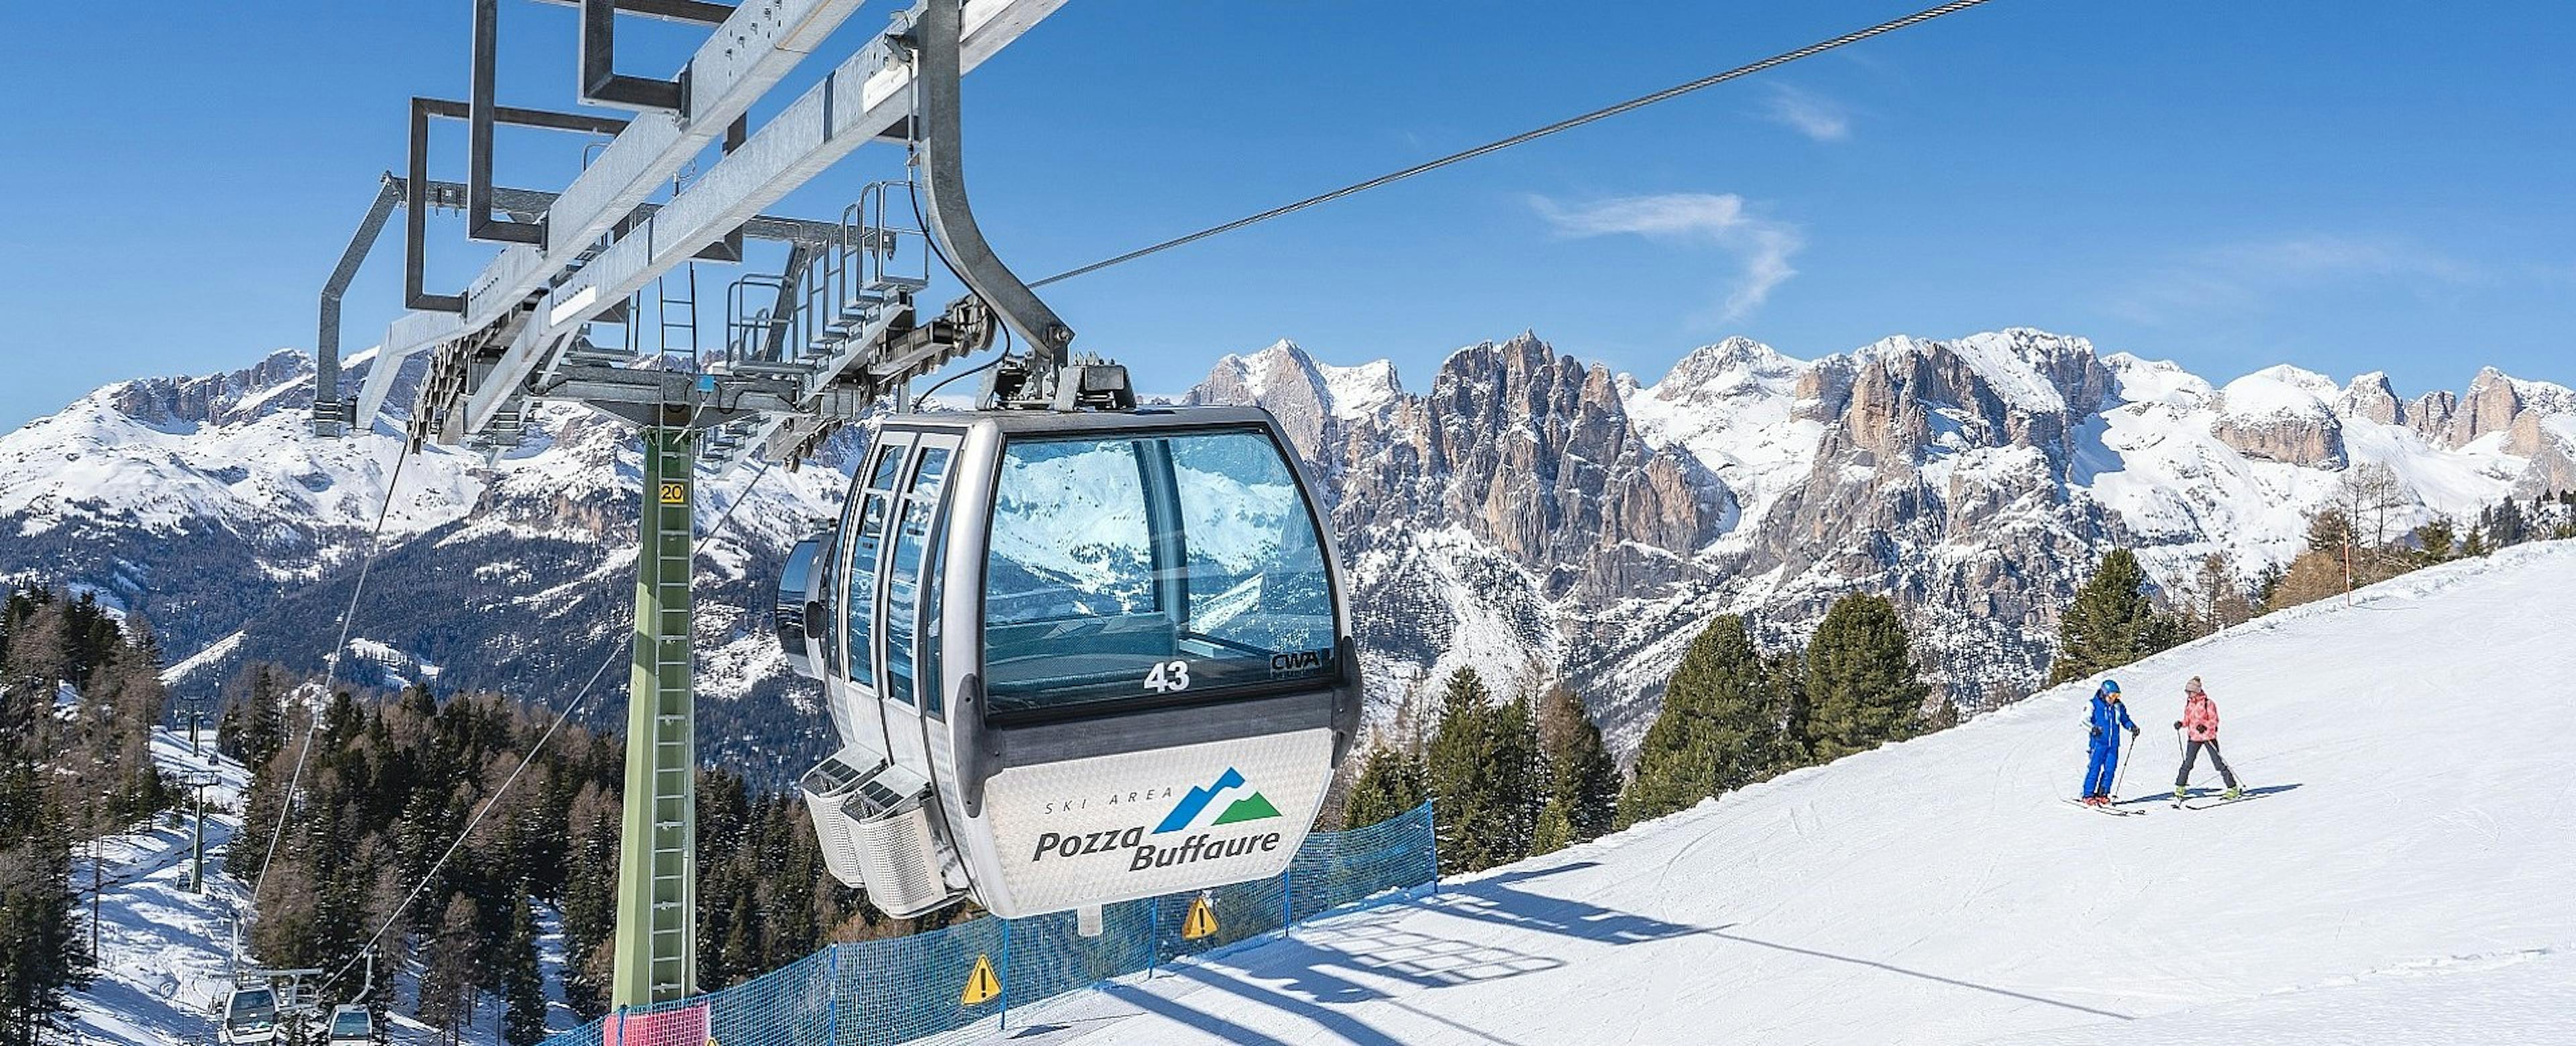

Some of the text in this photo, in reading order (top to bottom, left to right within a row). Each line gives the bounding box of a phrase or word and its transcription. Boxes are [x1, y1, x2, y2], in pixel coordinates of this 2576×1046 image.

[661, 485, 682, 499] 20
[1272, 652, 1320, 669] CWA
[1144, 660, 1190, 693] 43
[1045, 787, 1172, 815] SKI AREA
[1032, 826, 1145, 862] Pozza
[1128, 832, 1281, 872] Buffaure
